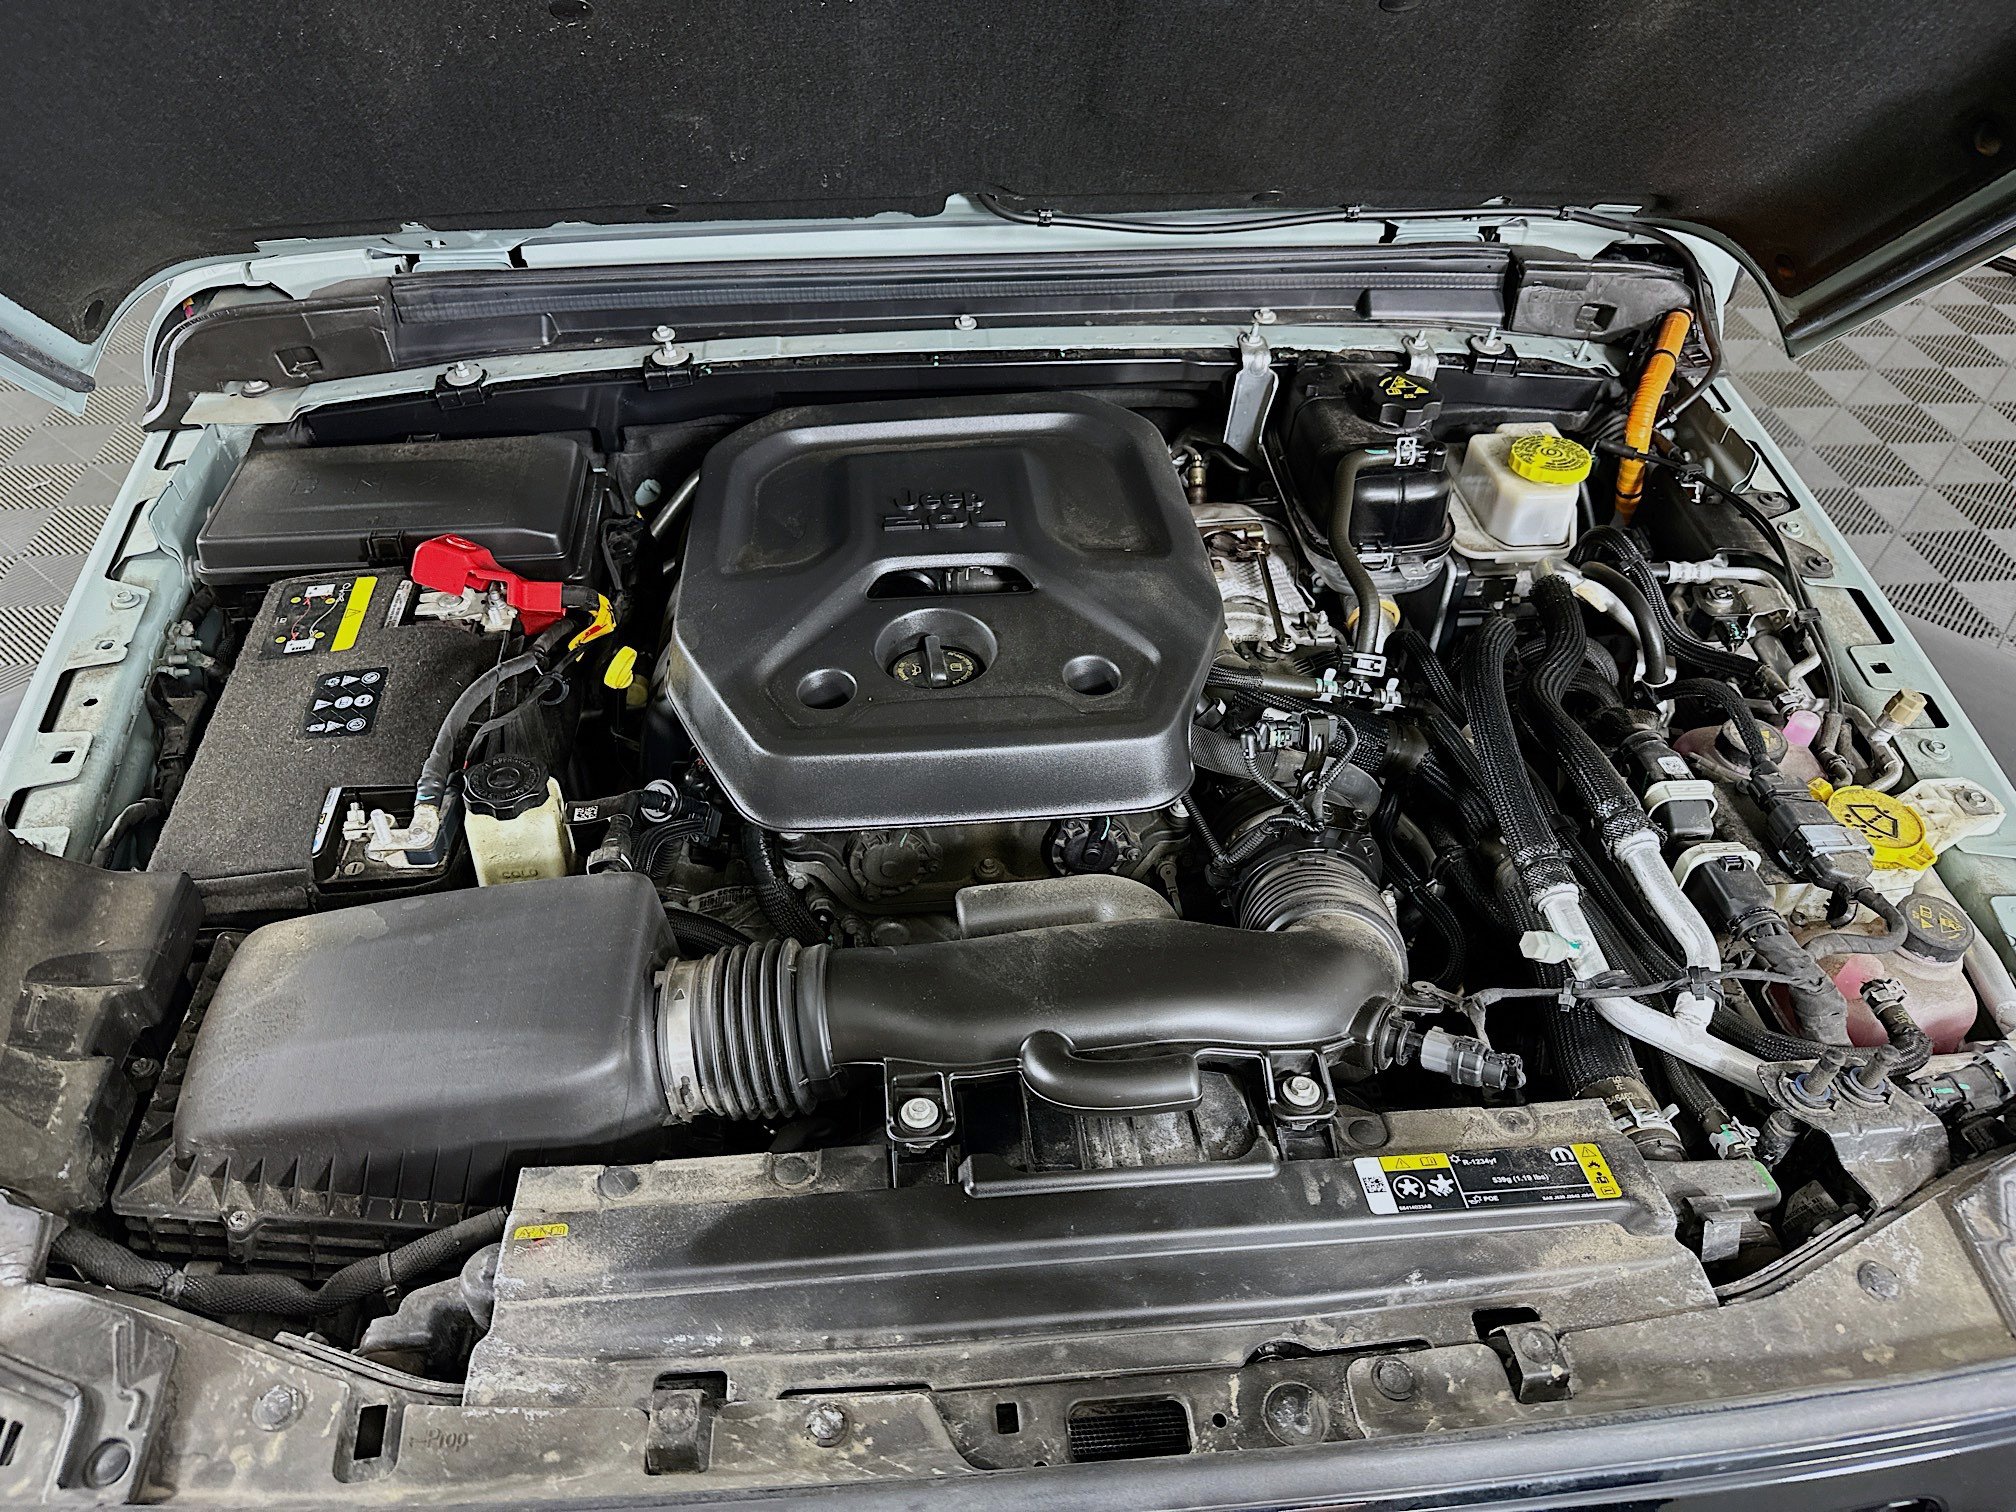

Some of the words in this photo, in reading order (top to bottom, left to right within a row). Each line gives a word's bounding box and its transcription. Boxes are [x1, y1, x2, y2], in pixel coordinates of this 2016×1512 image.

[894, 490, 985, 514] Jeep
[884, 512, 1007, 531] 2.0L
[1463, 1157, 1497, 1167] R-1234yf
[1483, 1195, 1499, 1203] POE
